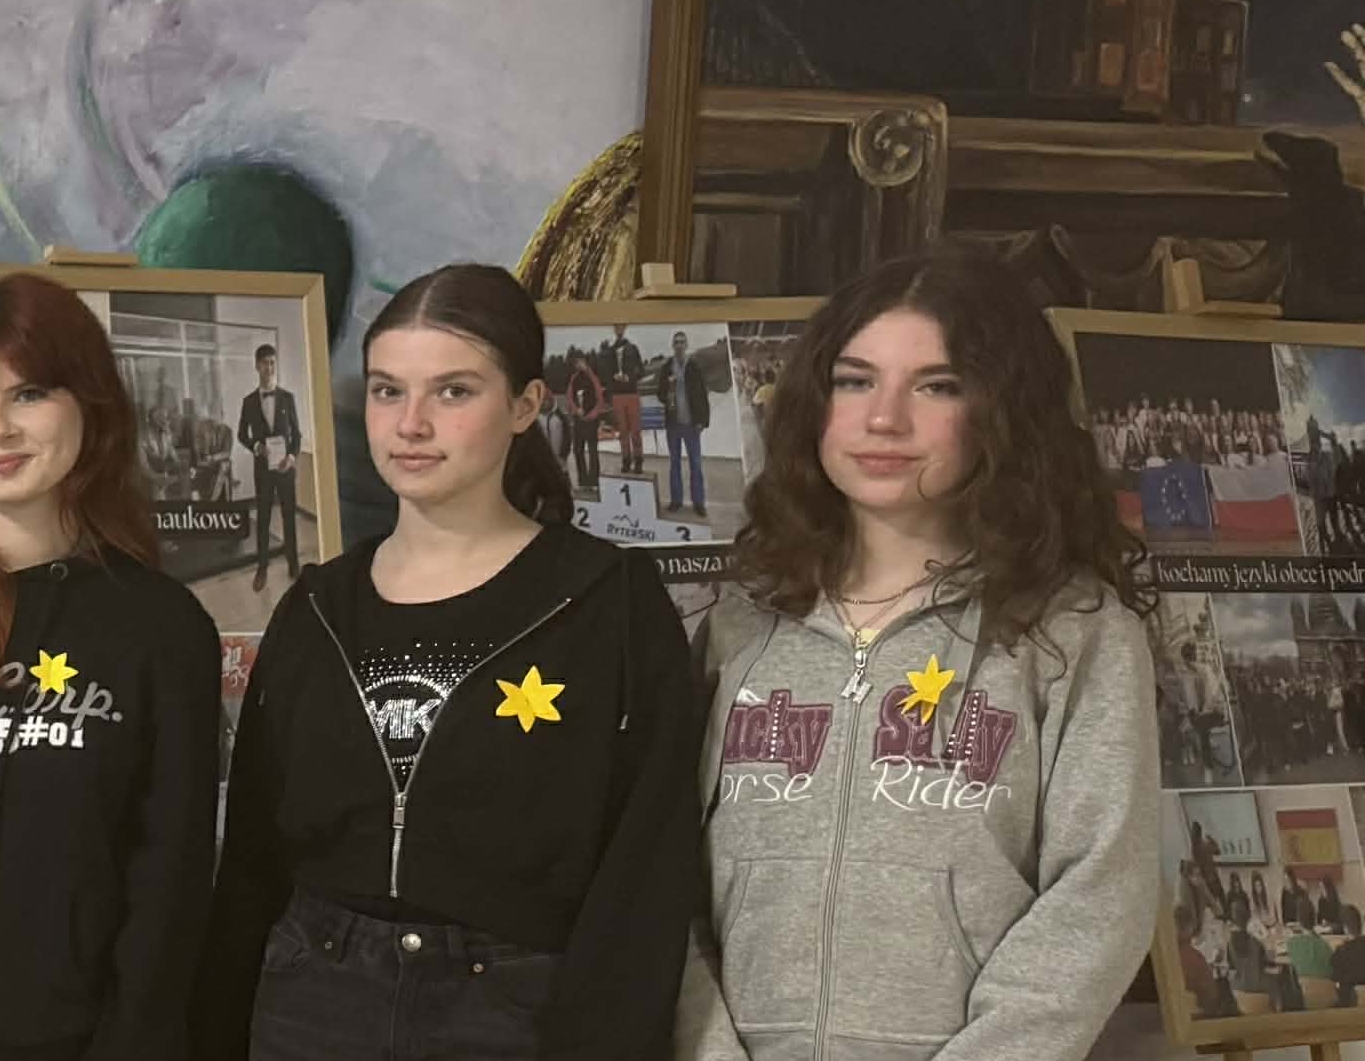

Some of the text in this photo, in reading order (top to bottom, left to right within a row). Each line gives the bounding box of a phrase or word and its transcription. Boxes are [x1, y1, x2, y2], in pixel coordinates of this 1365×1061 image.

[619, 483, 632, 507] 1
[155, 504, 242, 530] naukowe
[576, 507, 591, 528] 2
[668, 556, 723, 574] nasza
[1279, 561, 1318, 584] obce
[1319, 563, 1326, 584] i
[723, 689, 833, 780] ucky
[722, 755, 1012, 812] orse Rider
